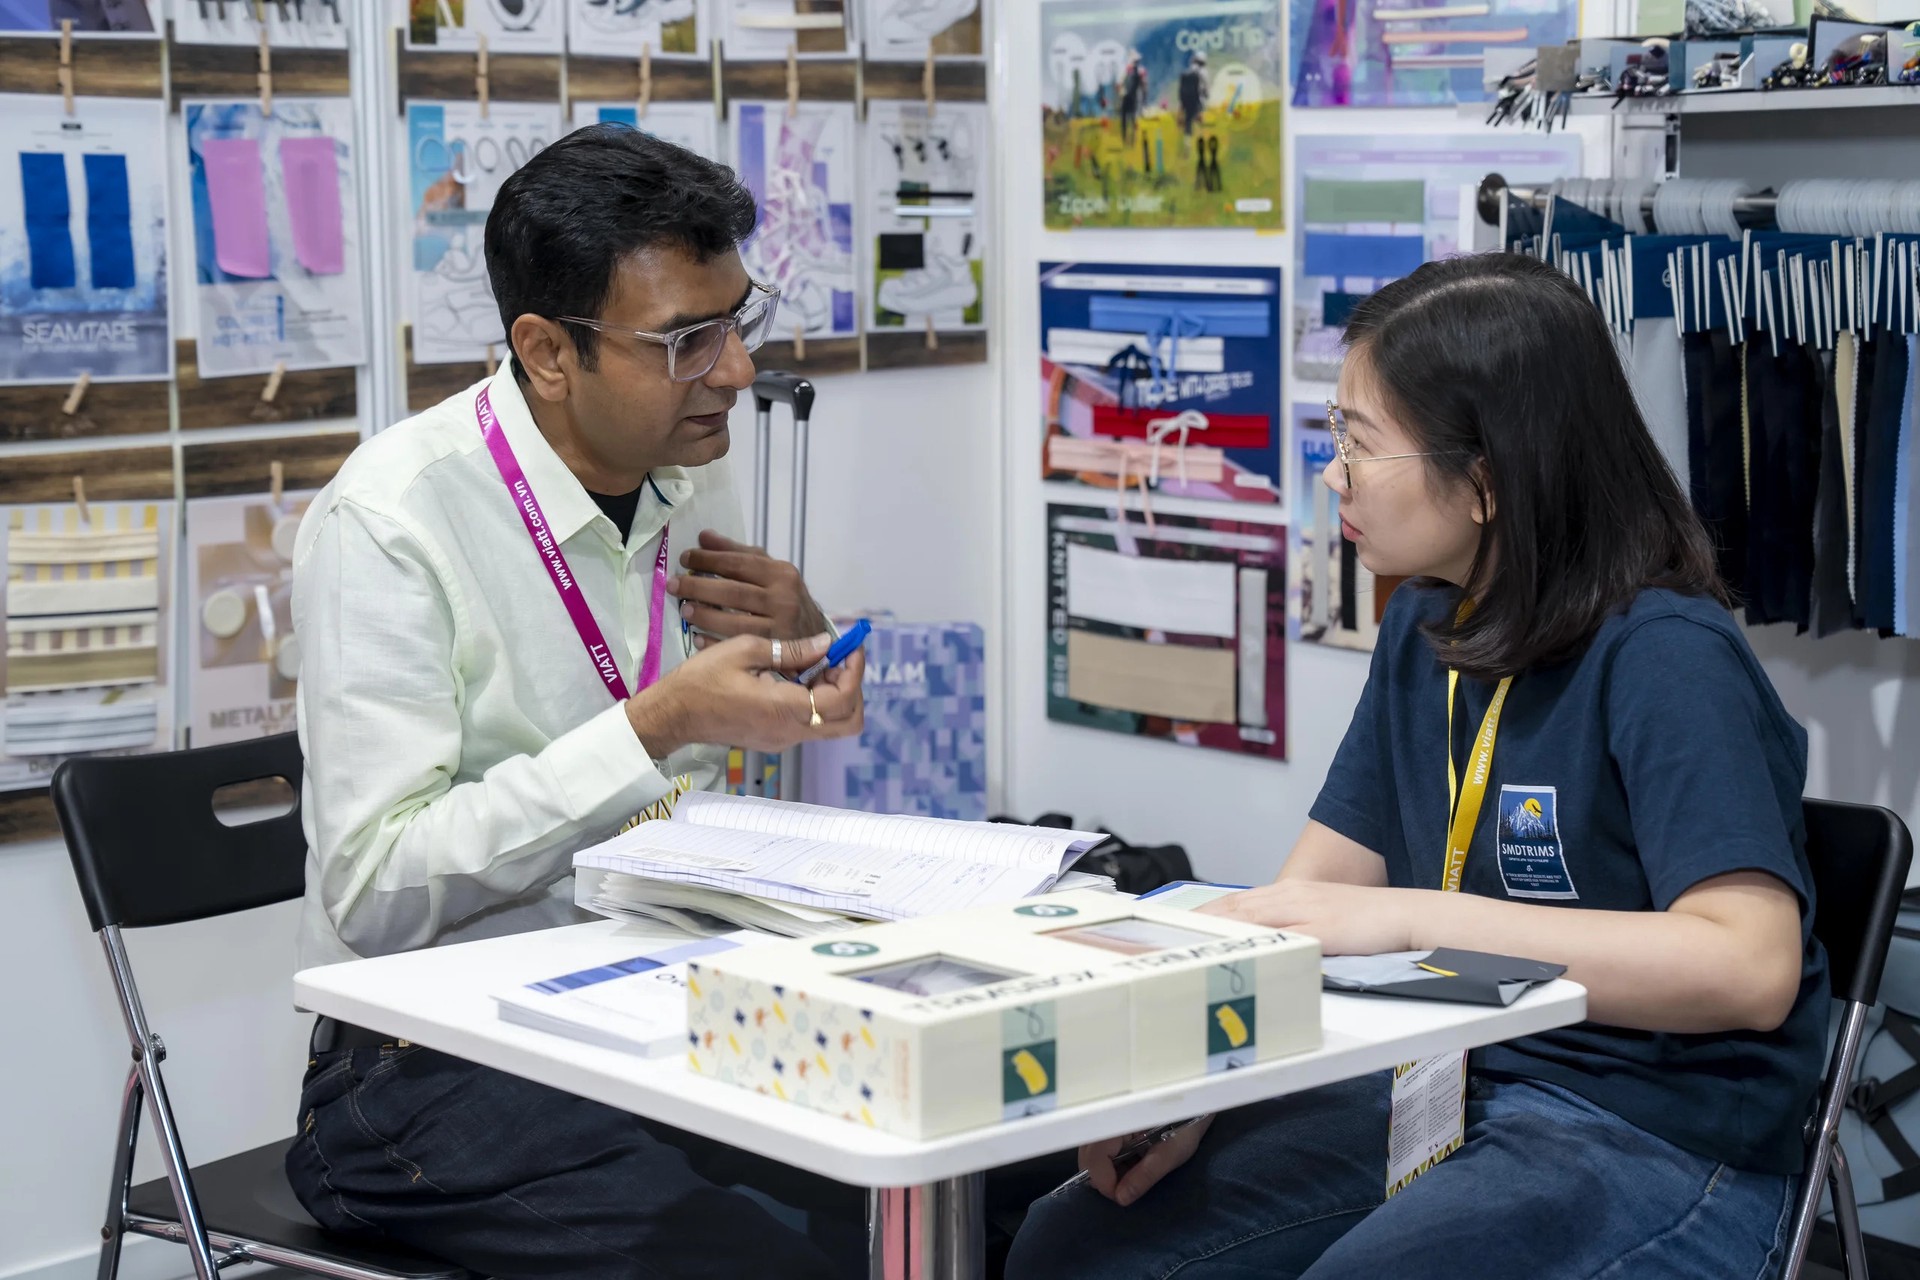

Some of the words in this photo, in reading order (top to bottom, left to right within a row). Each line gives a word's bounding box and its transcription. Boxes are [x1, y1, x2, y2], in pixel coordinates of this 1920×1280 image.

[1175, 25, 1225, 51] Cord
[22, 320, 137, 345] SEAMTAPE
[477, 393, 494, 430] VIATT
[514, 480, 573, 591] www.viatt.com.vn
[590, 643, 618, 685] VIATT
[1502, 843, 1555, 857] SMDTRIMS
[1447, 846, 1464, 893] VIATT
